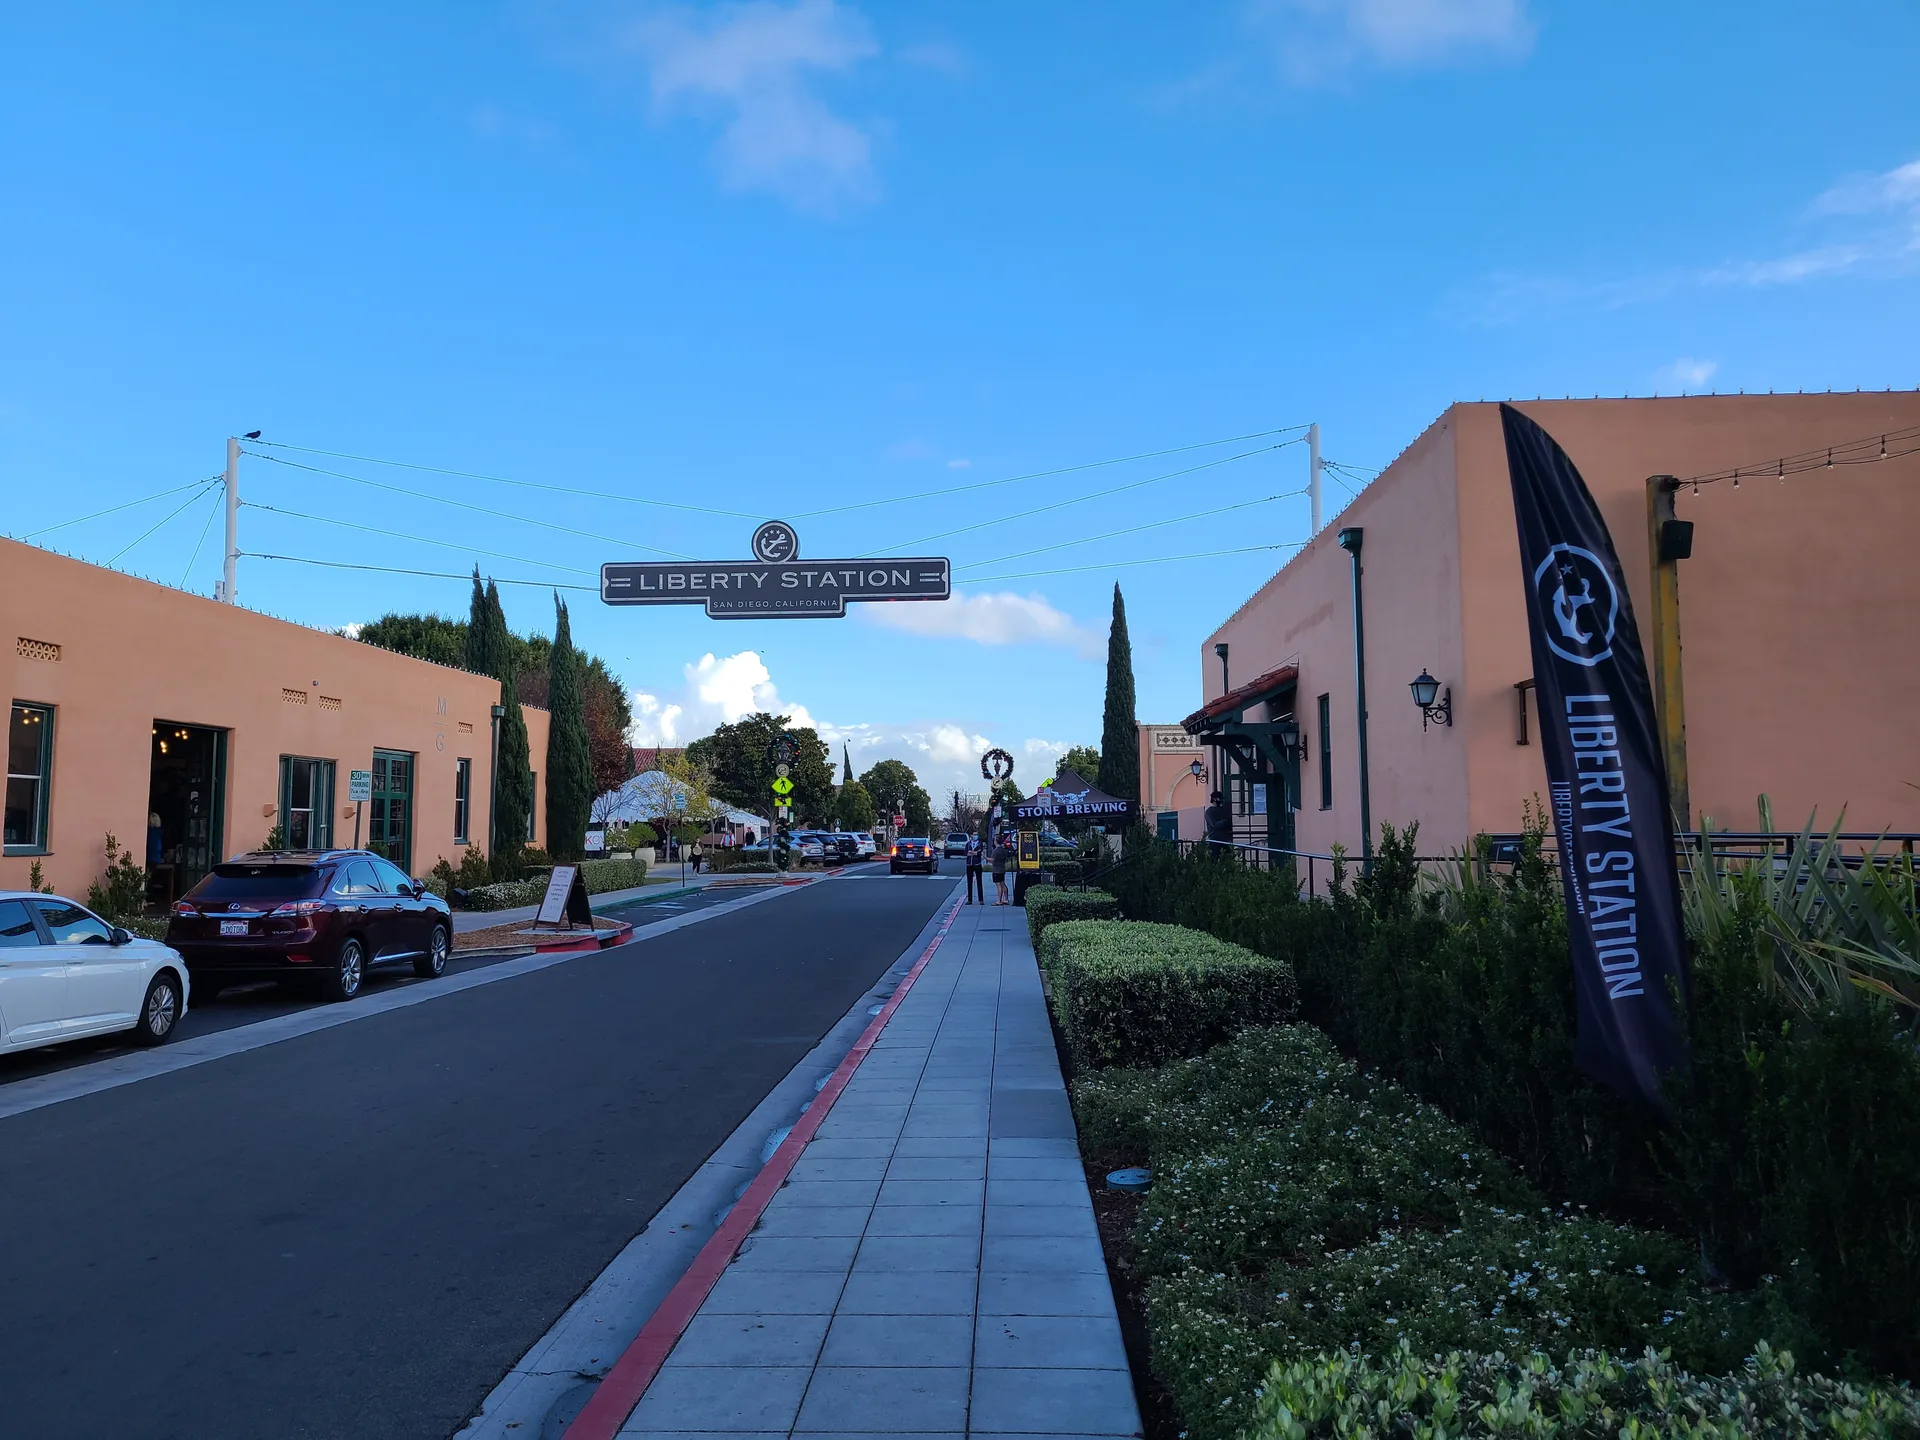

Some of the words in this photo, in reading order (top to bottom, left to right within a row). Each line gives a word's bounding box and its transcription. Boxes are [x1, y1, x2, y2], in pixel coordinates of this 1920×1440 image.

[639, 572, 770, 590] LIBERTY
[780, 569, 911, 588] STATION
[713, 601, 734, 609] SAN
[737, 600, 772, 609] DIEGO,
[775, 599, 839, 608] CALIFORNIA
[437, 696, 446, 715] M
[436, 733, 444, 752] G
[351, 771, 361, 779] 30
[1564, 693, 1632, 838] LIBERTY
[1018, 805, 1060, 818] STONE
[1066, 802, 1127, 815] BREWING
[1586, 851, 1644, 1000] STATION
